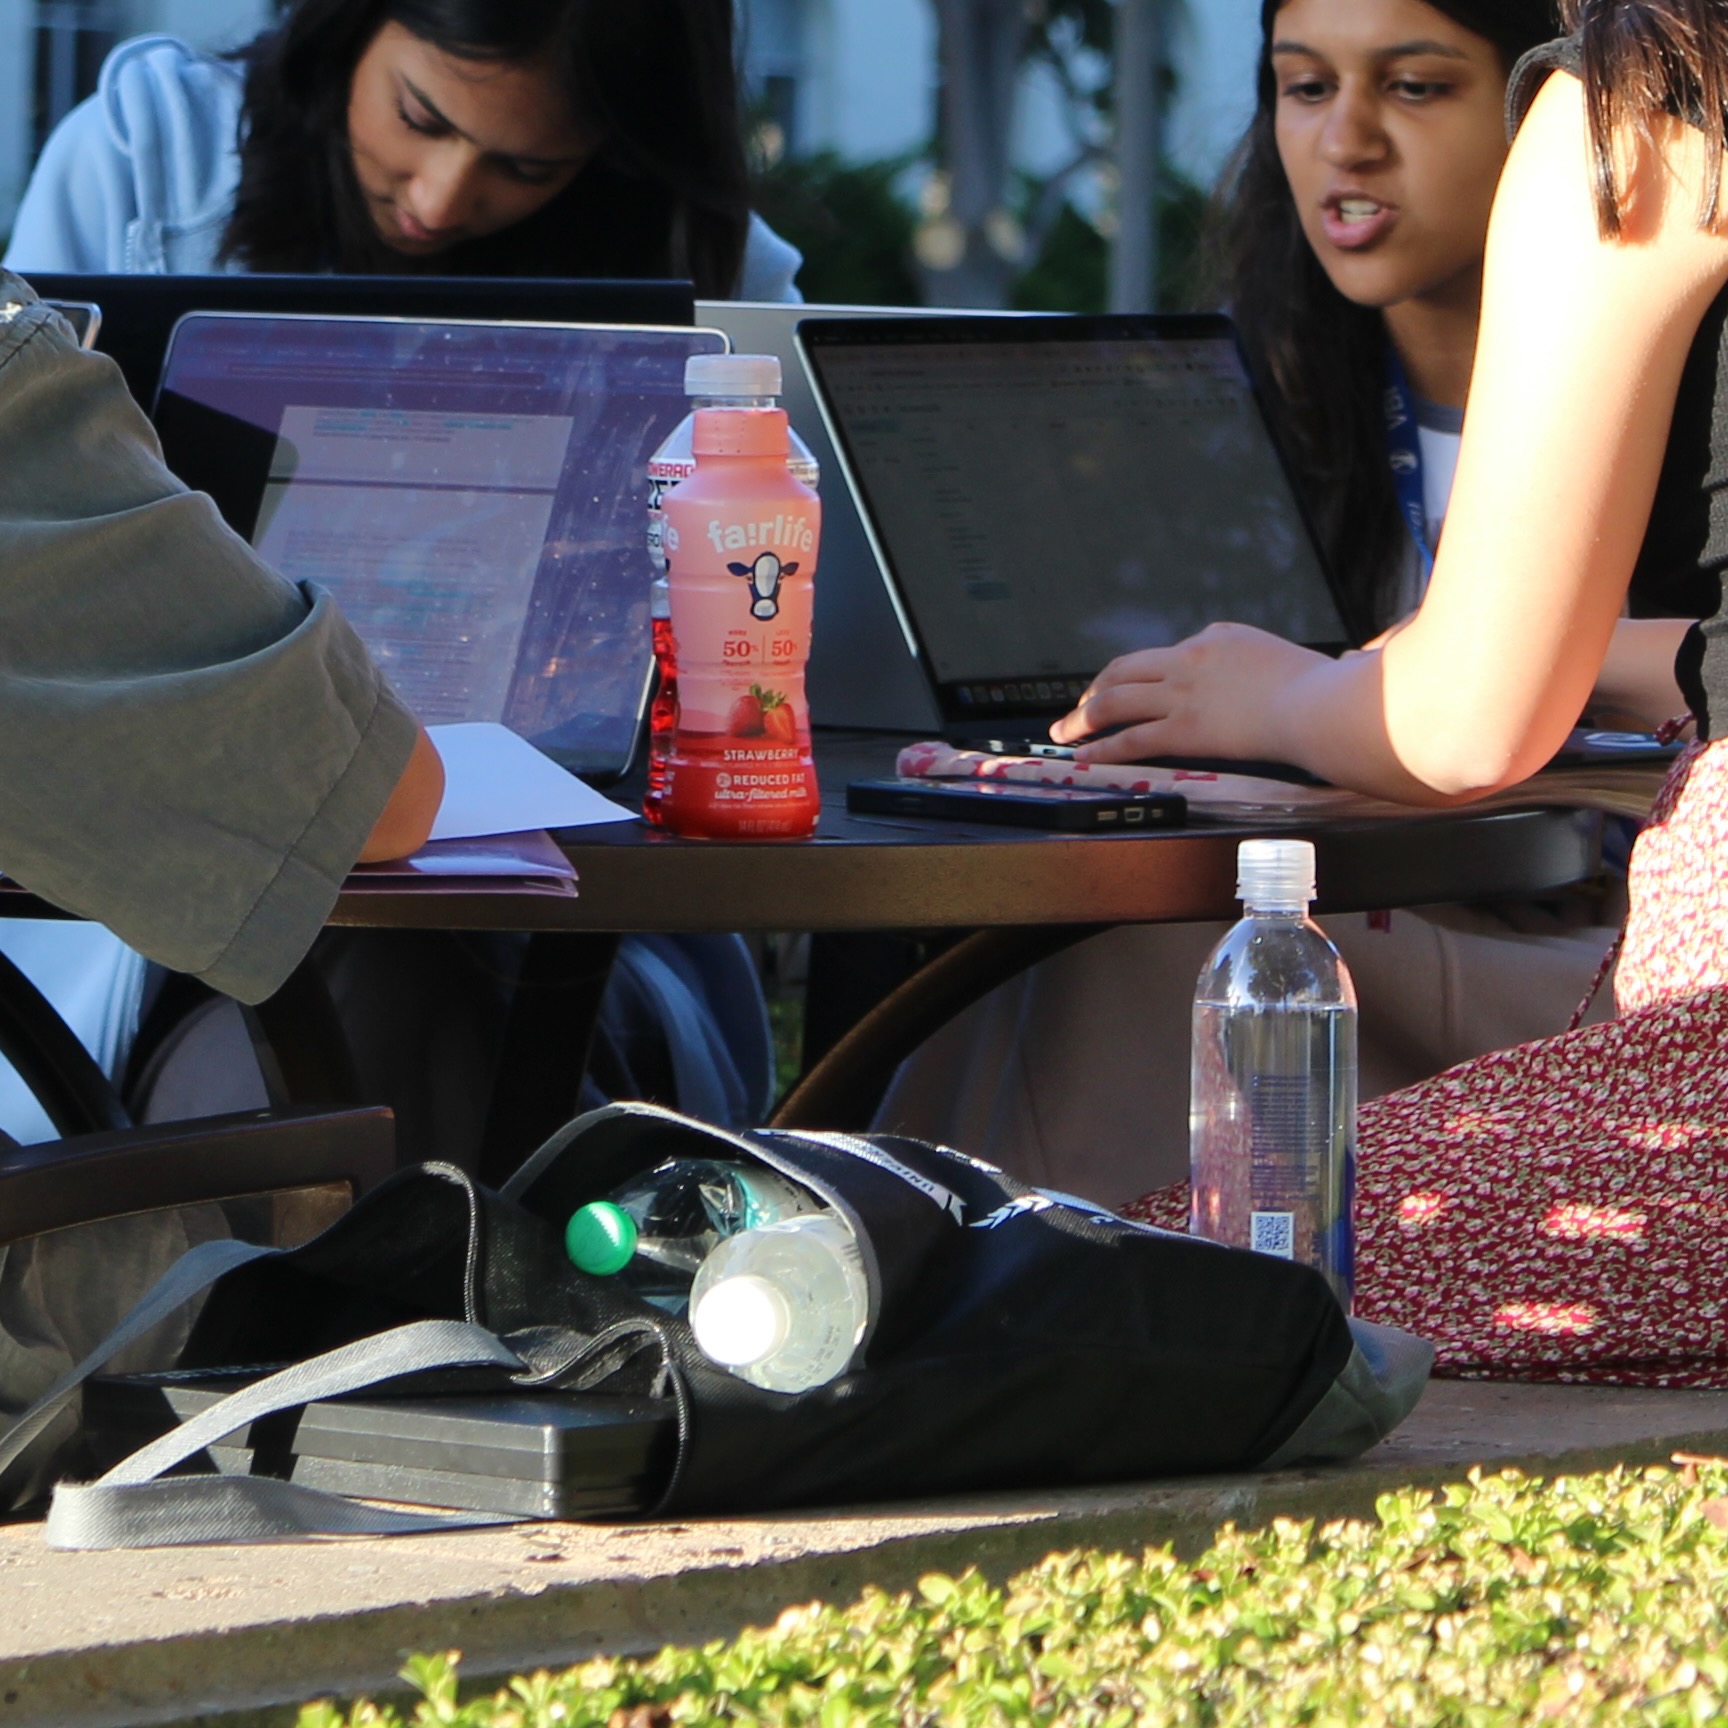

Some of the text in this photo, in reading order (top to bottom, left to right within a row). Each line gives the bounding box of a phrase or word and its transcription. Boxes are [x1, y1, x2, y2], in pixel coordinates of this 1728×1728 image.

[723, 748, 799, 761] STRAWBERRY
[733, 774, 789, 786] REDUCED
[791, 772, 805, 783] FAT
